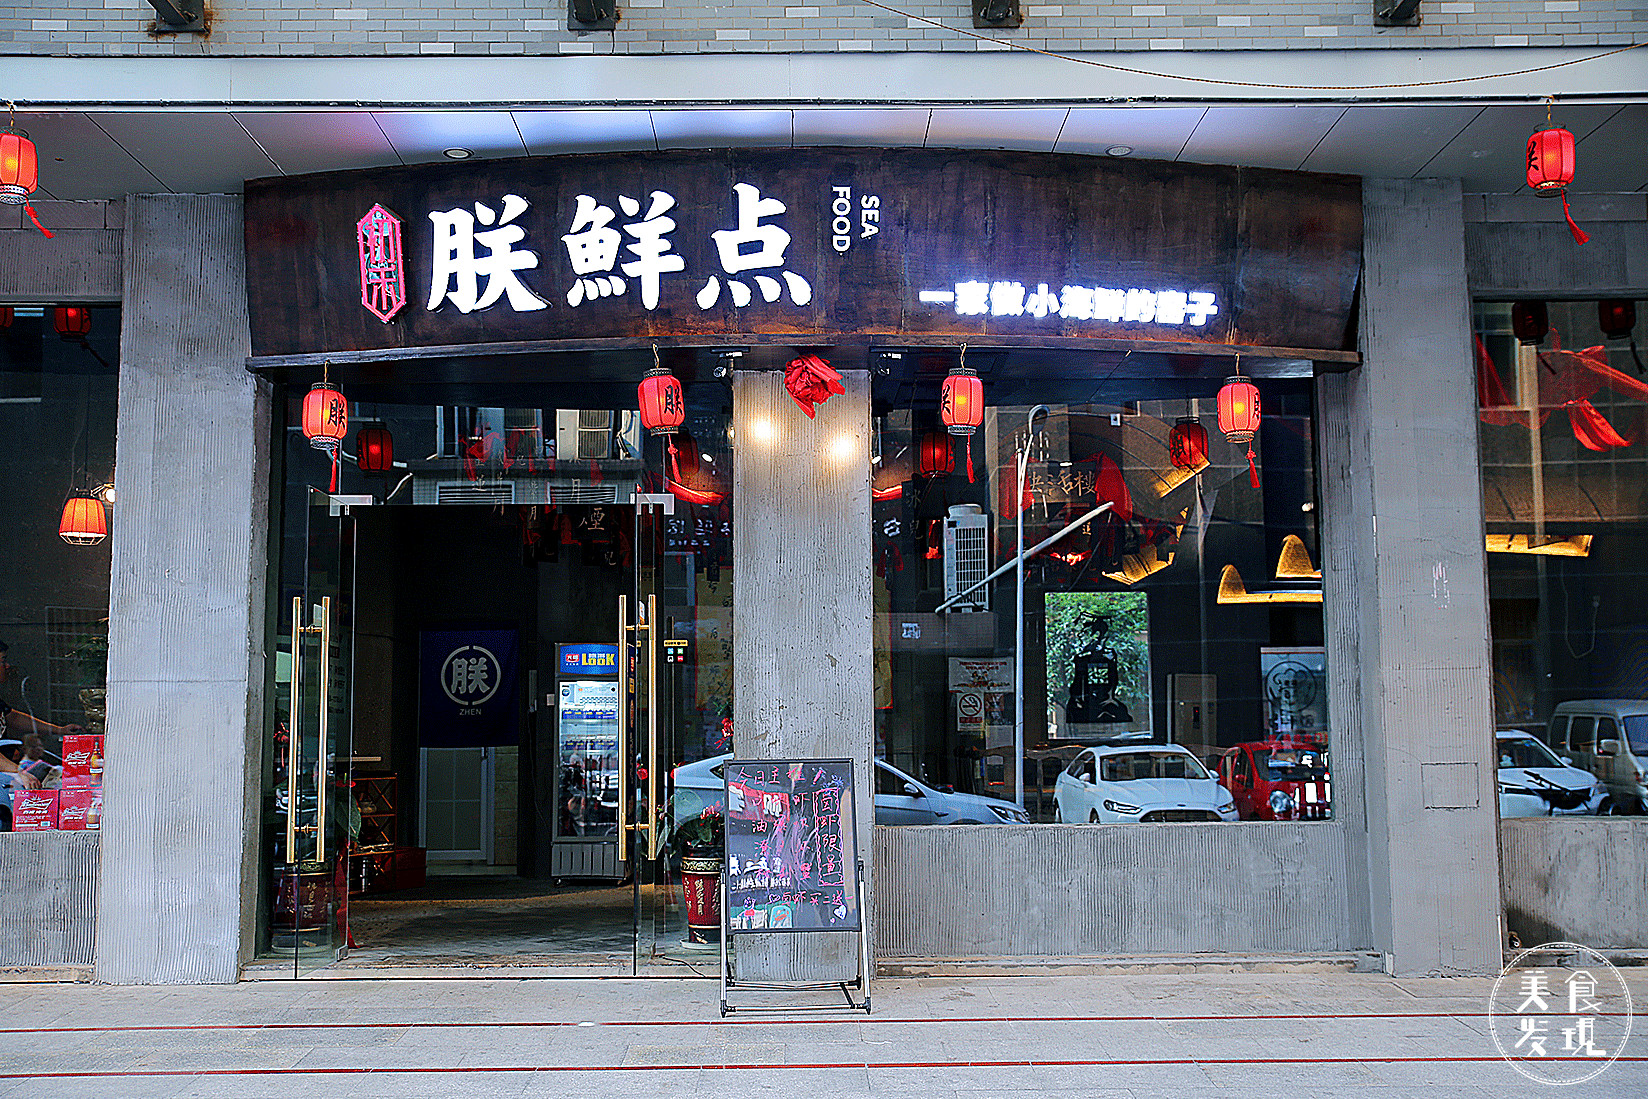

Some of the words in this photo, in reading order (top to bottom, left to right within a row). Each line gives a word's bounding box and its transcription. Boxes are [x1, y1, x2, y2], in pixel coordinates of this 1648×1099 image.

[831, 185, 851, 256] FOOD
[860, 194, 880, 240] SEA
[427, 183, 811, 314] 朕鮮点
[450, 656, 491, 695] 朕
[459, 708, 482, 716] ZHEN
